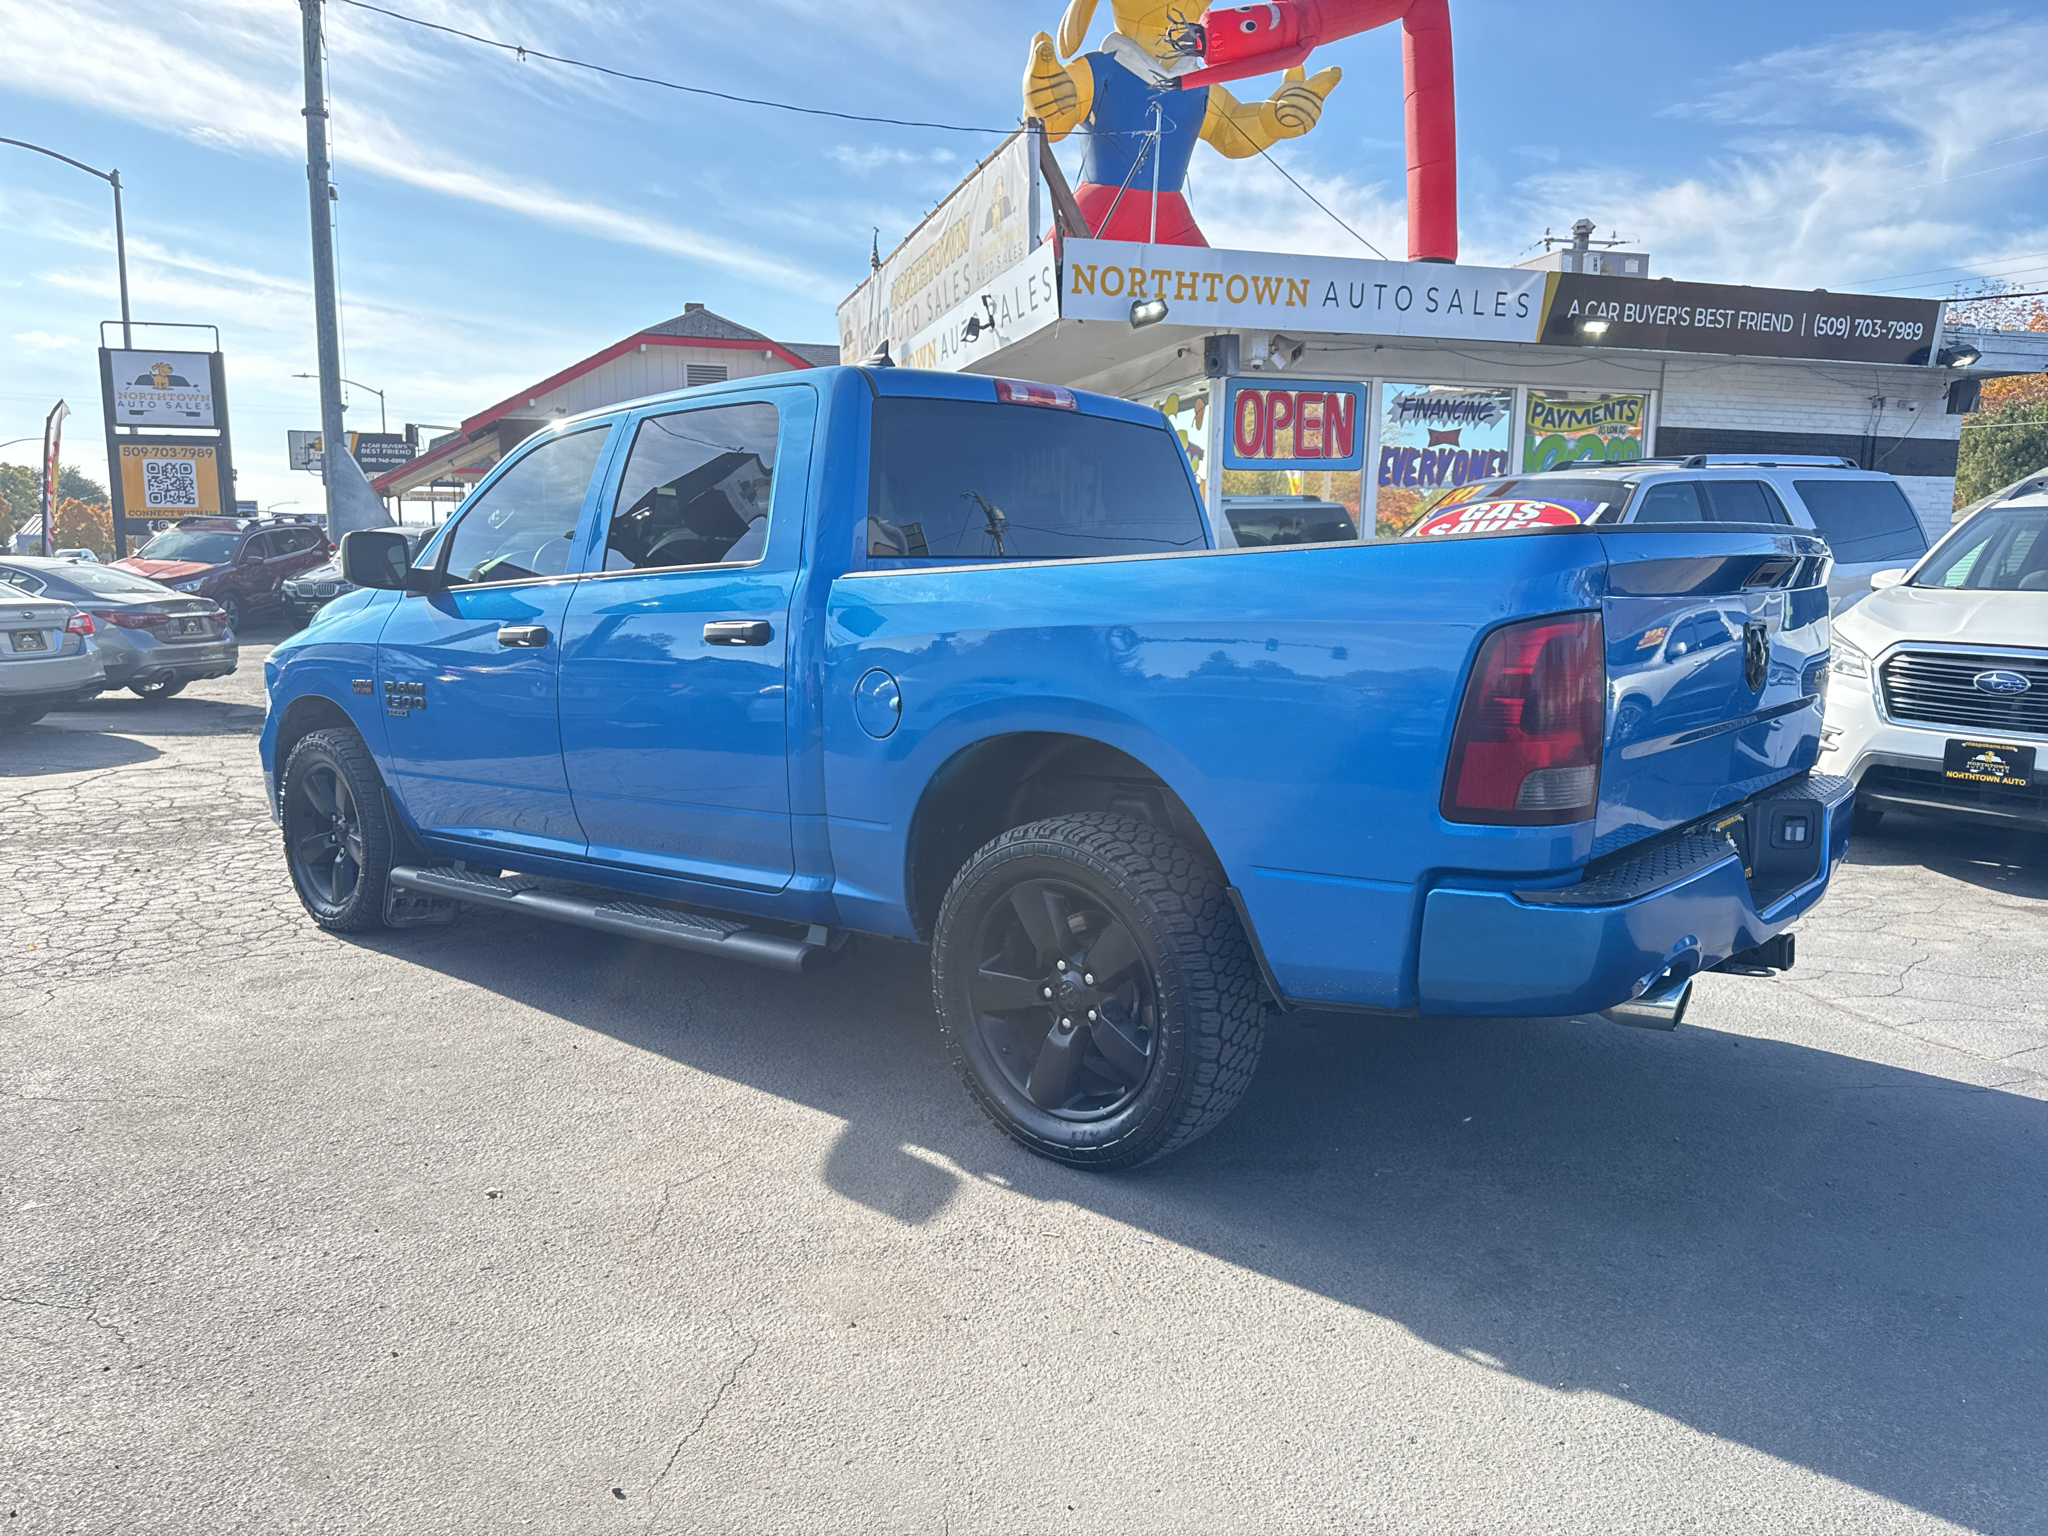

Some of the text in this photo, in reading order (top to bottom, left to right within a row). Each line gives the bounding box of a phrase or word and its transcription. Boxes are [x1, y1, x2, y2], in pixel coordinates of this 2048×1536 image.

[890, 214, 971, 311] NORTHTOWN
[997, 241, 1023, 269] SALES
[1071, 263, 1530, 319] NORTHTOWN AUTO SALES
[889, 262, 971, 348] AUTO SALES
[1568, 299, 1580, 319] A
[1584, 300, 1620, 322] CAR
[1623, 303, 1690, 327] BUYER'S
[1694, 308, 1735, 330] BEST
[1737, 311, 1794, 334] FRIEND
[1813, 313, 1850, 340] (509)
[1854, 318, 1924, 341] 703-7989
[117, 391, 210, 402] NORTHTOWN
[117, 400, 211, 411] AUTO SALES
[1400, 397, 1494, 421] FINANCING
[1531, 399, 1639, 429] PAYMENTS
[1233, 388, 1355, 460] OPEN
[1598, 425, 1626, 435] AS LOW AS
[122, 446, 213, 459] 509-703-7989
[1378, 445, 1508, 488] EVERYONE!
[128, 509, 176, 517] CONNECT
[384, 680, 426, 696] RAM
[385, 695, 428, 711] 1500
[1967, 761, 2010, 769] NORTHTOWN
[1946, 770, 2027, 786] NORTHTOWN AUTO
